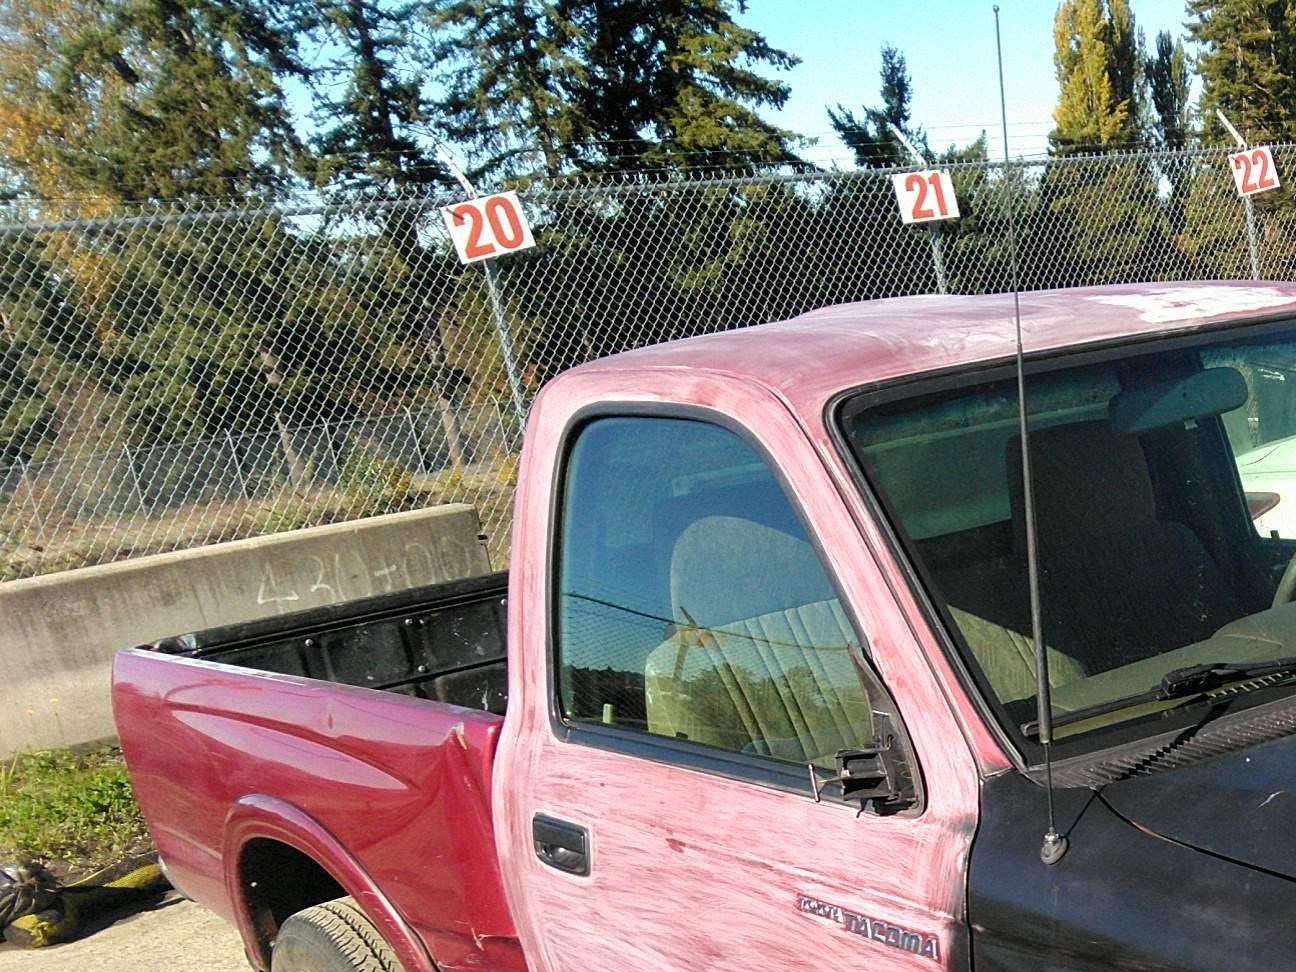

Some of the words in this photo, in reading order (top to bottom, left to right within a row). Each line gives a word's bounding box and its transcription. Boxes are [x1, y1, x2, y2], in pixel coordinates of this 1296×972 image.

[905, 172, 949, 220] 21
[1235, 149, 1275, 194] 22
[452, 196, 524, 259] 20
[844, 910, 938, 961] TACOMA
